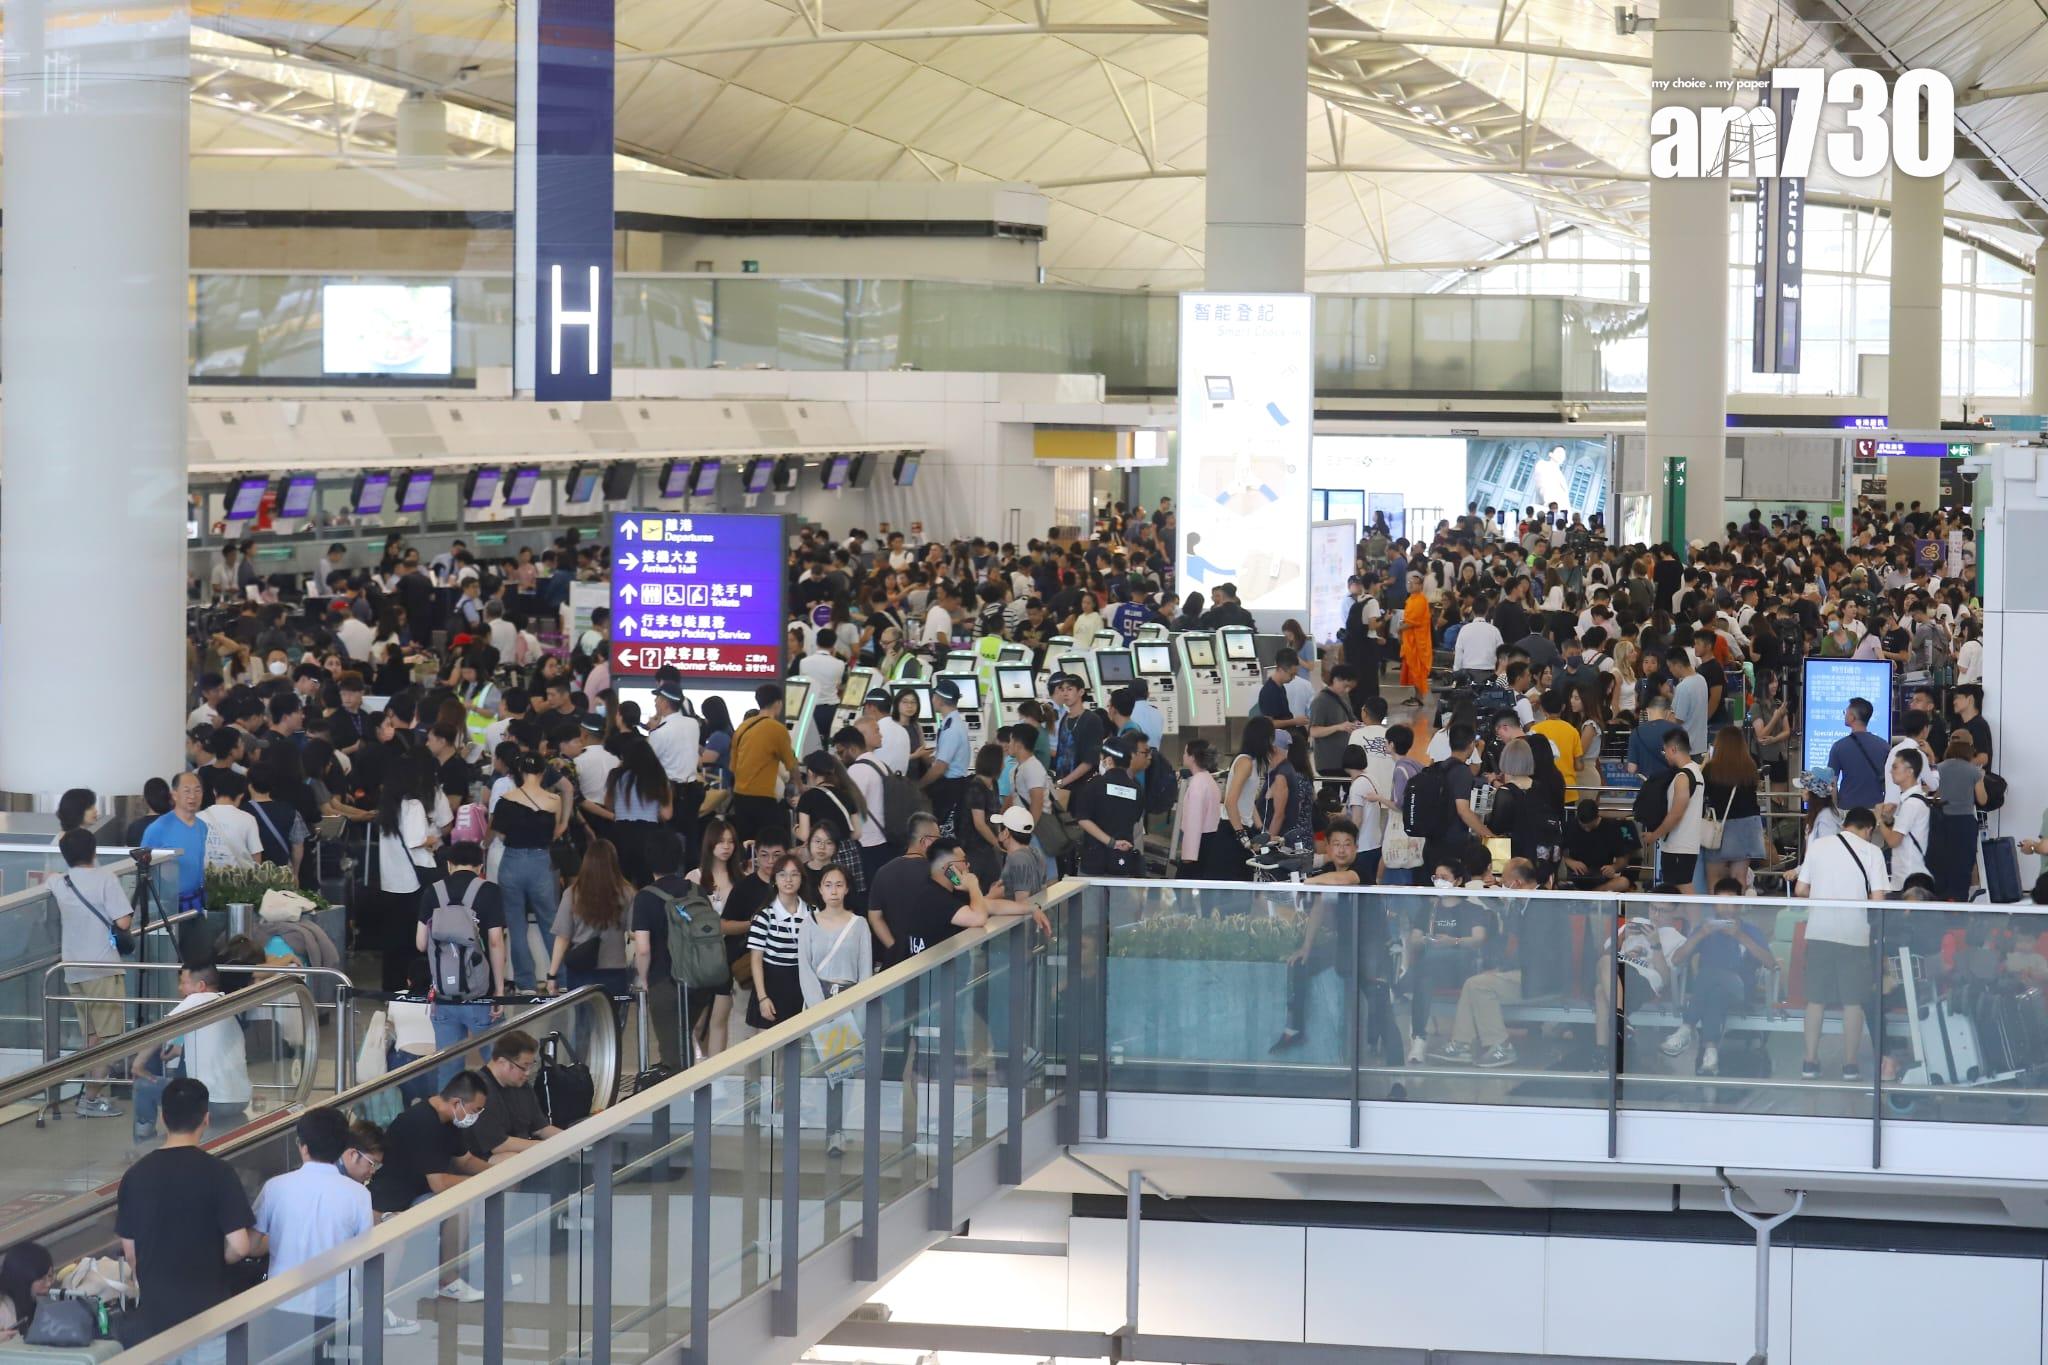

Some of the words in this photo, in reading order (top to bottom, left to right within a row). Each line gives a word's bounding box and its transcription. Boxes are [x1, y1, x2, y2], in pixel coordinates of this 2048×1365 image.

[550, 265, 599, 375] H
[664, 518, 693, 532] 離港
[664, 532, 714, 543] Departures
[641, 564, 676, 574] Arrivals
[678, 564, 697, 574] Hall
[711, 584, 753, 598] 洗手間
[711, 597, 741, 607] Toilets
[640, 627, 680, 639] Baggage
[681, 629, 716, 641] Packing
[717, 629, 751, 640] Service
[709, 661, 743, 672] Service
